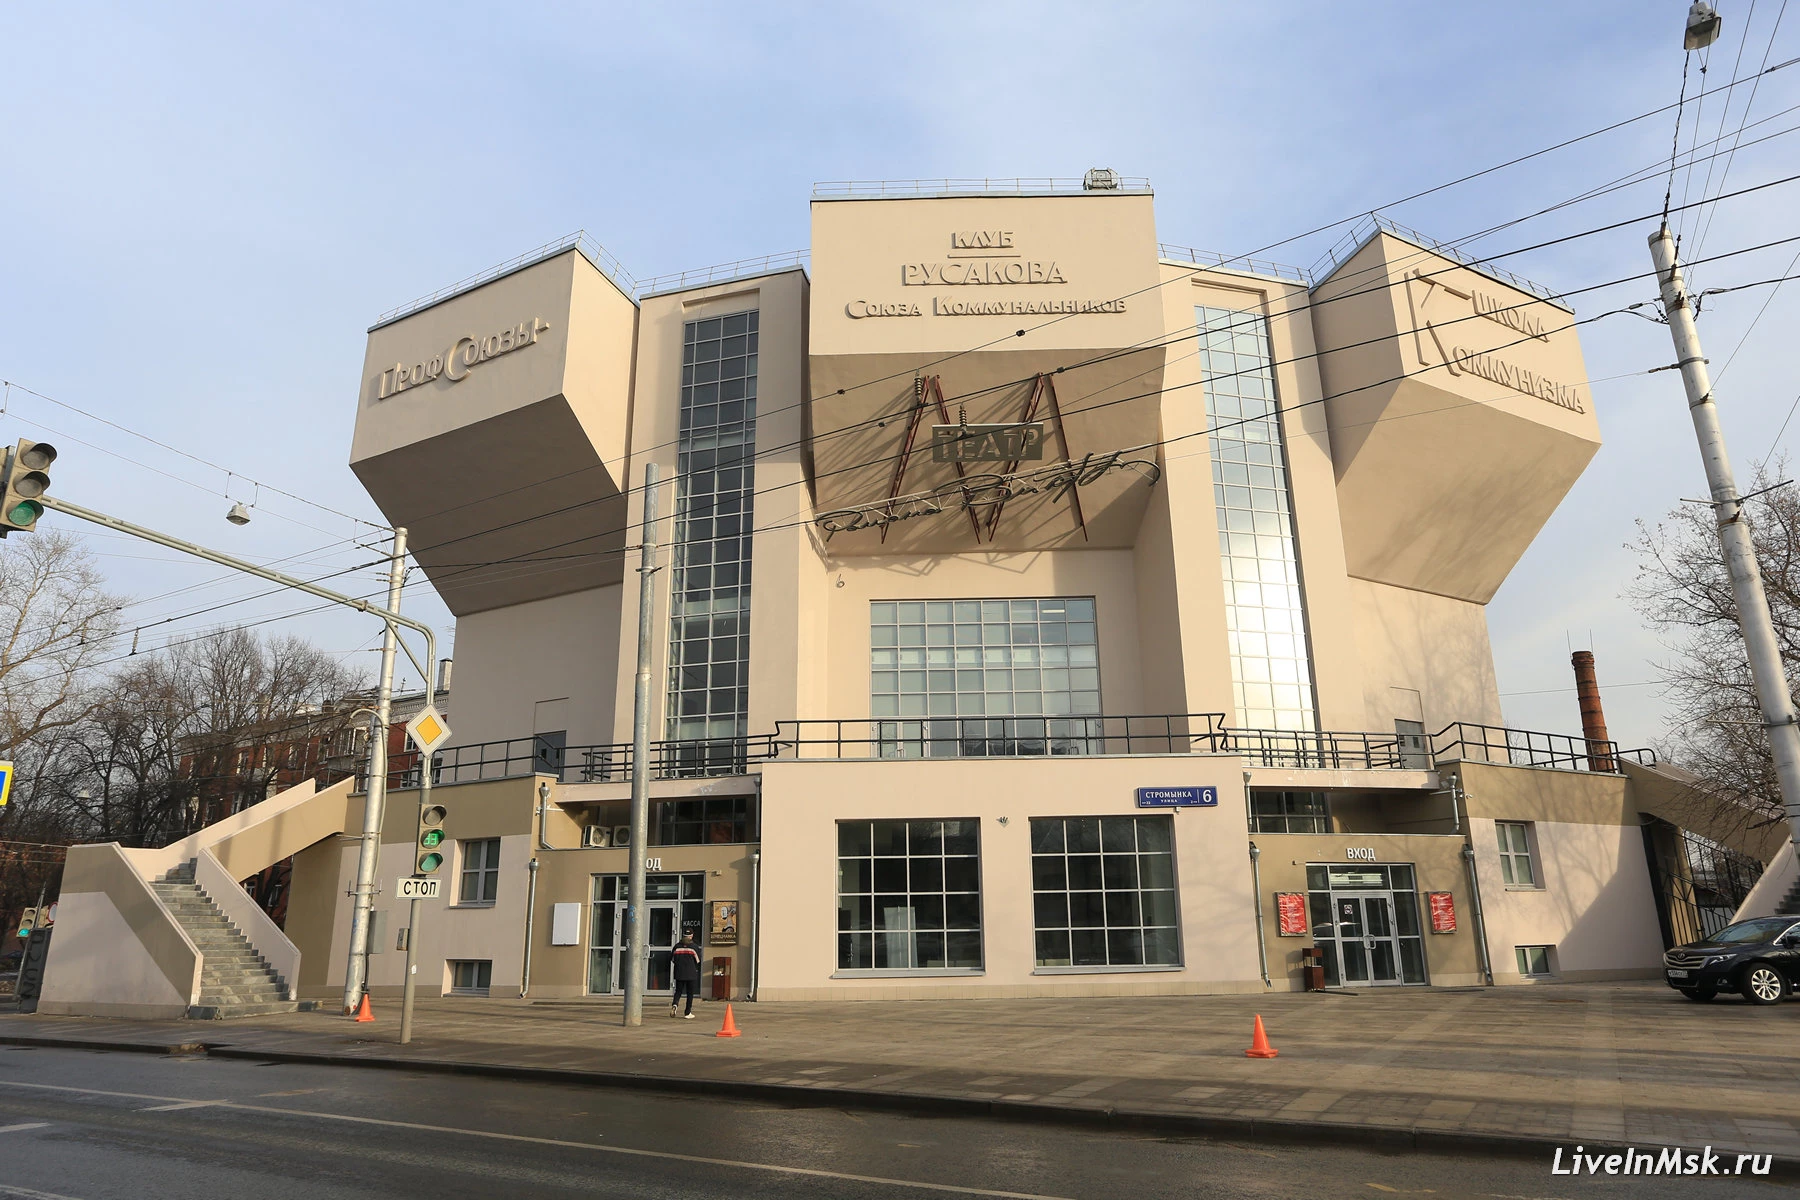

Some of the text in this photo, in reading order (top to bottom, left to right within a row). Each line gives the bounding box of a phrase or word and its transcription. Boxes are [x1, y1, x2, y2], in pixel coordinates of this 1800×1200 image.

[951, 230, 1015, 250] КЛУБ
[901, 261, 1068, 287] РУСАКОВА
[932, 296, 1127, 317] КОММУНАЛЬНИКОВ
[937, 428, 1039, 459] ТЕАТР
[1145, 789, 1212, 803] СТРОМЫНКА 6
[1346, 847, 1376, 862] ВХОД
[646, 857, 662, 871] ОД
[403, 880, 437, 896] СТОП
